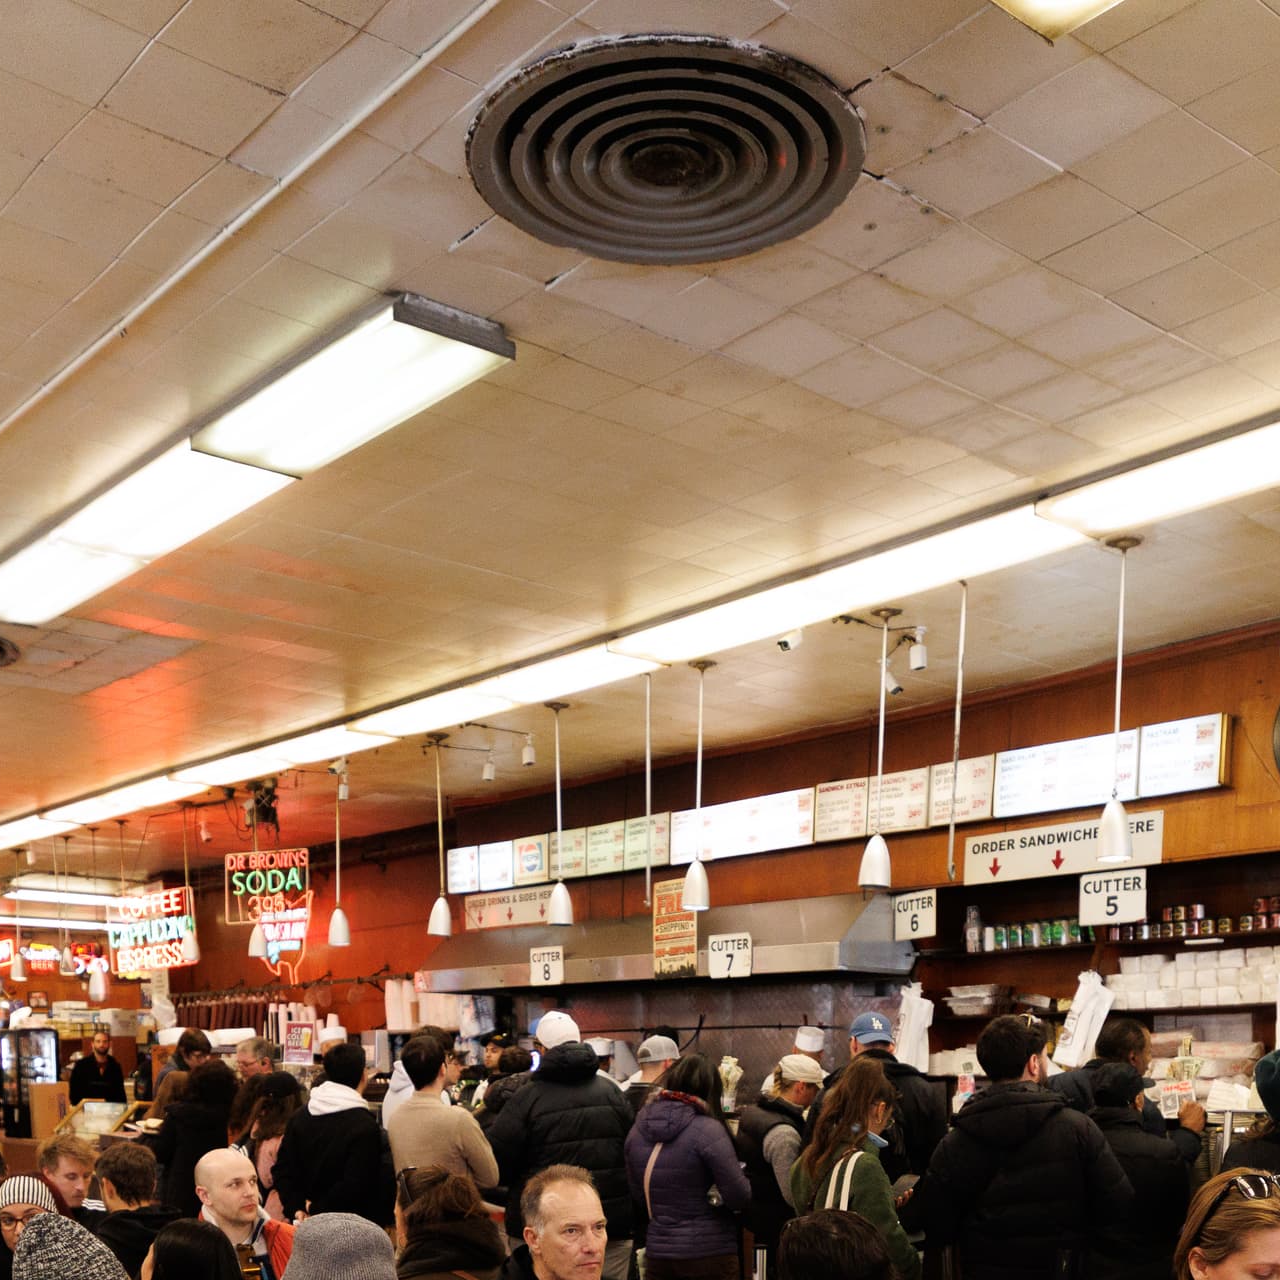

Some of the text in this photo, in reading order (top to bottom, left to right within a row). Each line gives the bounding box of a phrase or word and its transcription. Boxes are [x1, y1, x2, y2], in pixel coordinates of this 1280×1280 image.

[971, 837, 1016, 855] ORDER
[1019, 827, 1101, 849] SANDWICHE
[227, 854, 245, 870] DR
[232, 867, 303, 896] SODA
[1083, 876, 1142, 895] CUTTER
[118, 889, 182, 918] COFFEE
[247, 892, 286, 921] 395
[488, 895, 510, 906] DRINKS
[519, 891, 537, 902] SIDES
[897, 896, 933, 913] CUTTER
[1106, 895, 1119, 916] 5
[910, 914, 919, 932] 6
[710, 938, 749, 954] CUTTER
[117, 941, 186, 972] ESPRESS
[531, 951, 561, 964] CUTTER
[725, 953, 735, 972] 7
[542, 963, 551, 982] 8
[871, 1016, 883, 1030] LA
